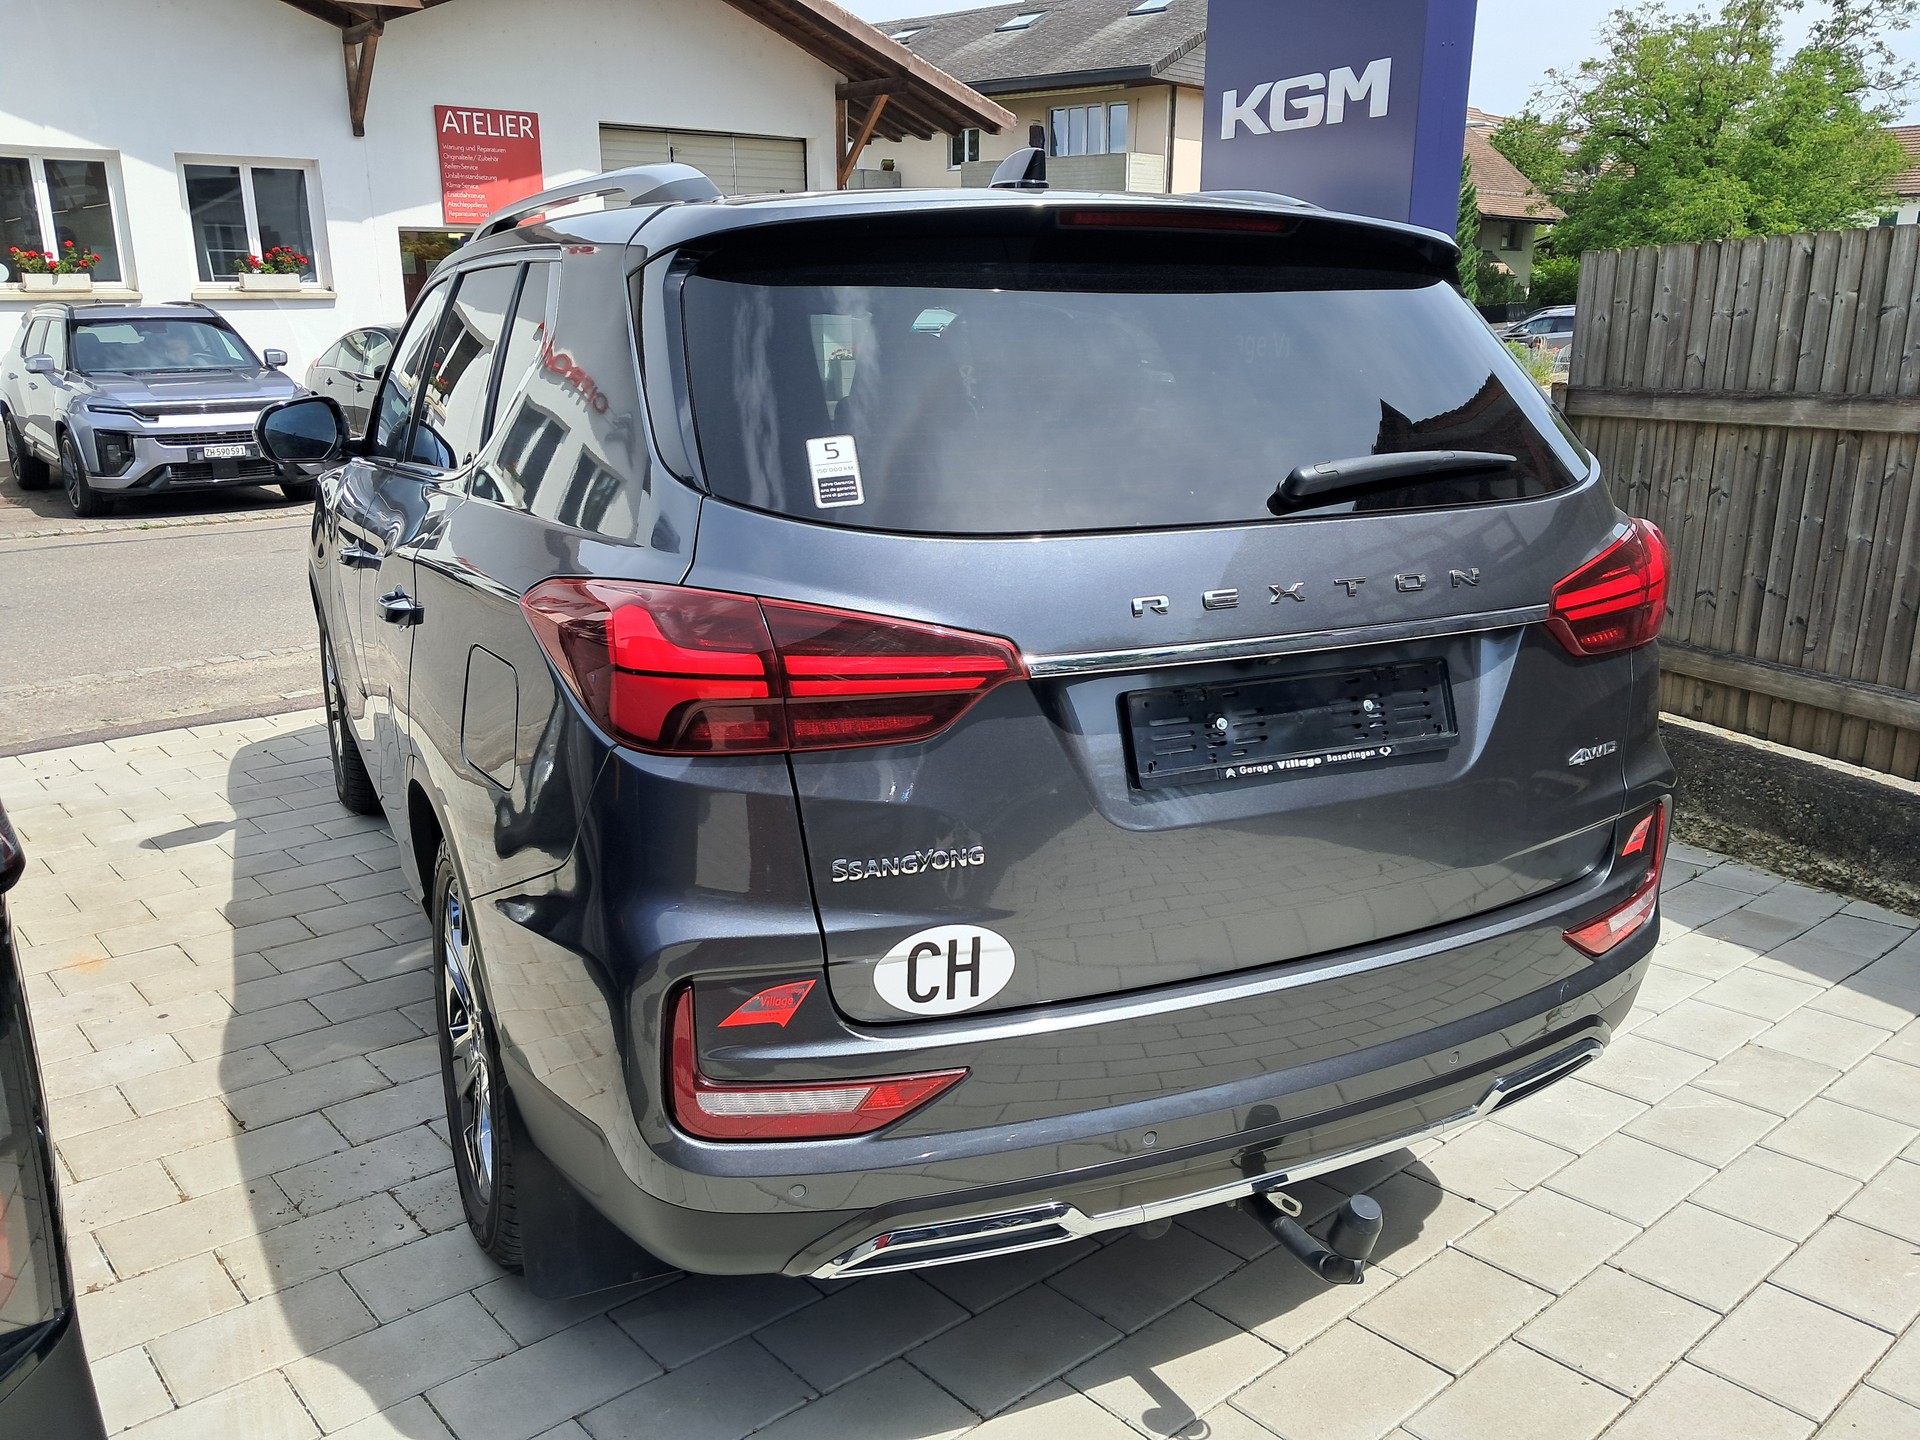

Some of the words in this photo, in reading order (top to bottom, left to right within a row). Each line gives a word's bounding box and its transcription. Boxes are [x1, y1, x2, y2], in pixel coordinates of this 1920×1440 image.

[1220, 56, 1393, 141] KGM
[442, 110, 535, 139] ATELIER
[442, 144, 465, 152] Wartung
[477, 145, 507, 153] Reparaturen
[824, 442, 840, 460] 5
[1131, 566, 1480, 618] REXTON
[1239, 764, 1274, 775] Garage
[1276, 757, 1323, 770] Village
[1326, 749, 1376, 763] Basadingen
[1568, 740, 1618, 767] 4WD
[906, 936, 982, 1004] CH
[760, 995, 794, 1009] Village
